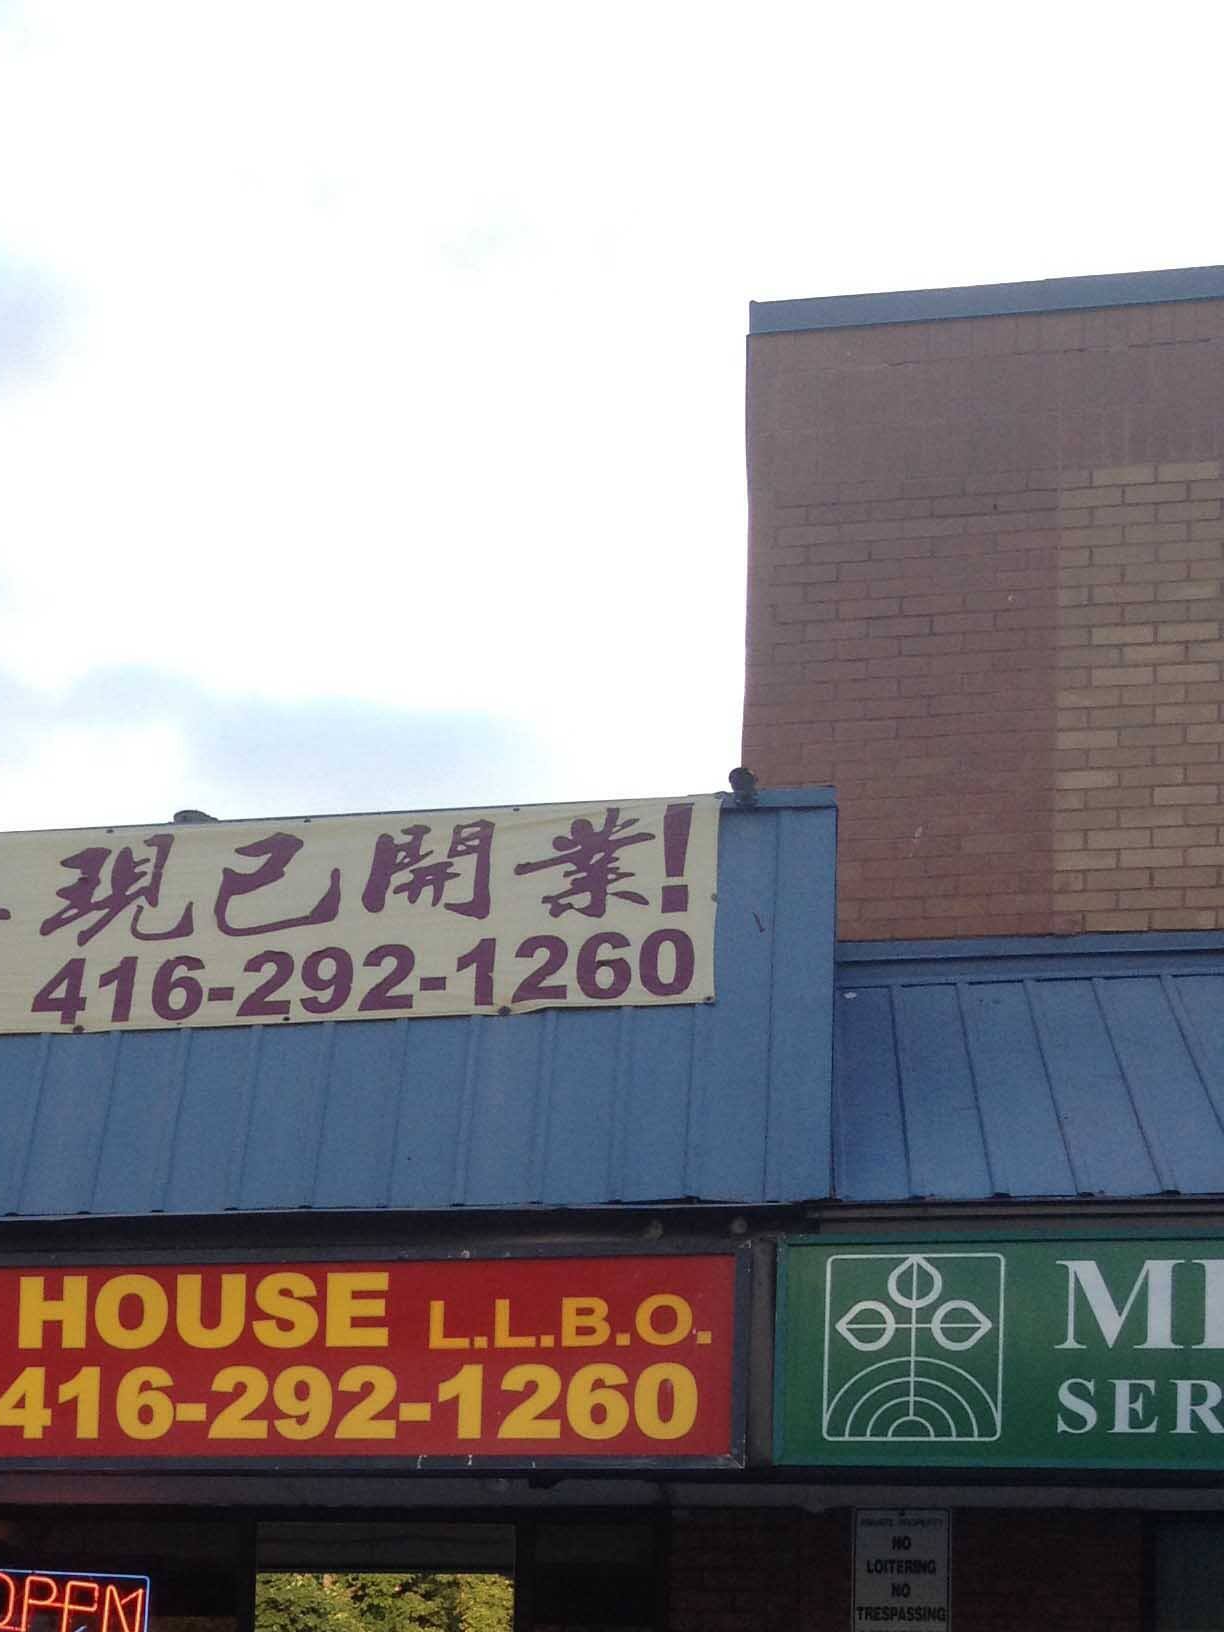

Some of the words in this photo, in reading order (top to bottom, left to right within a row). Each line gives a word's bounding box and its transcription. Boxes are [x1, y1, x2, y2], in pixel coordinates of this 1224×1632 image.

[30, 927, 696, 1026] 416-292-1260
[16, 1271, 390, 1352] HOUSE
[428, 1293, 713, 1351] L.L.B.O.
[891, 1535, 912, 1550] NO
[866, 1559, 937, 1575] LOITERING
[891, 1583, 912, 1598] NO
[856, 1606, 947, 1622] TRESPASSING
